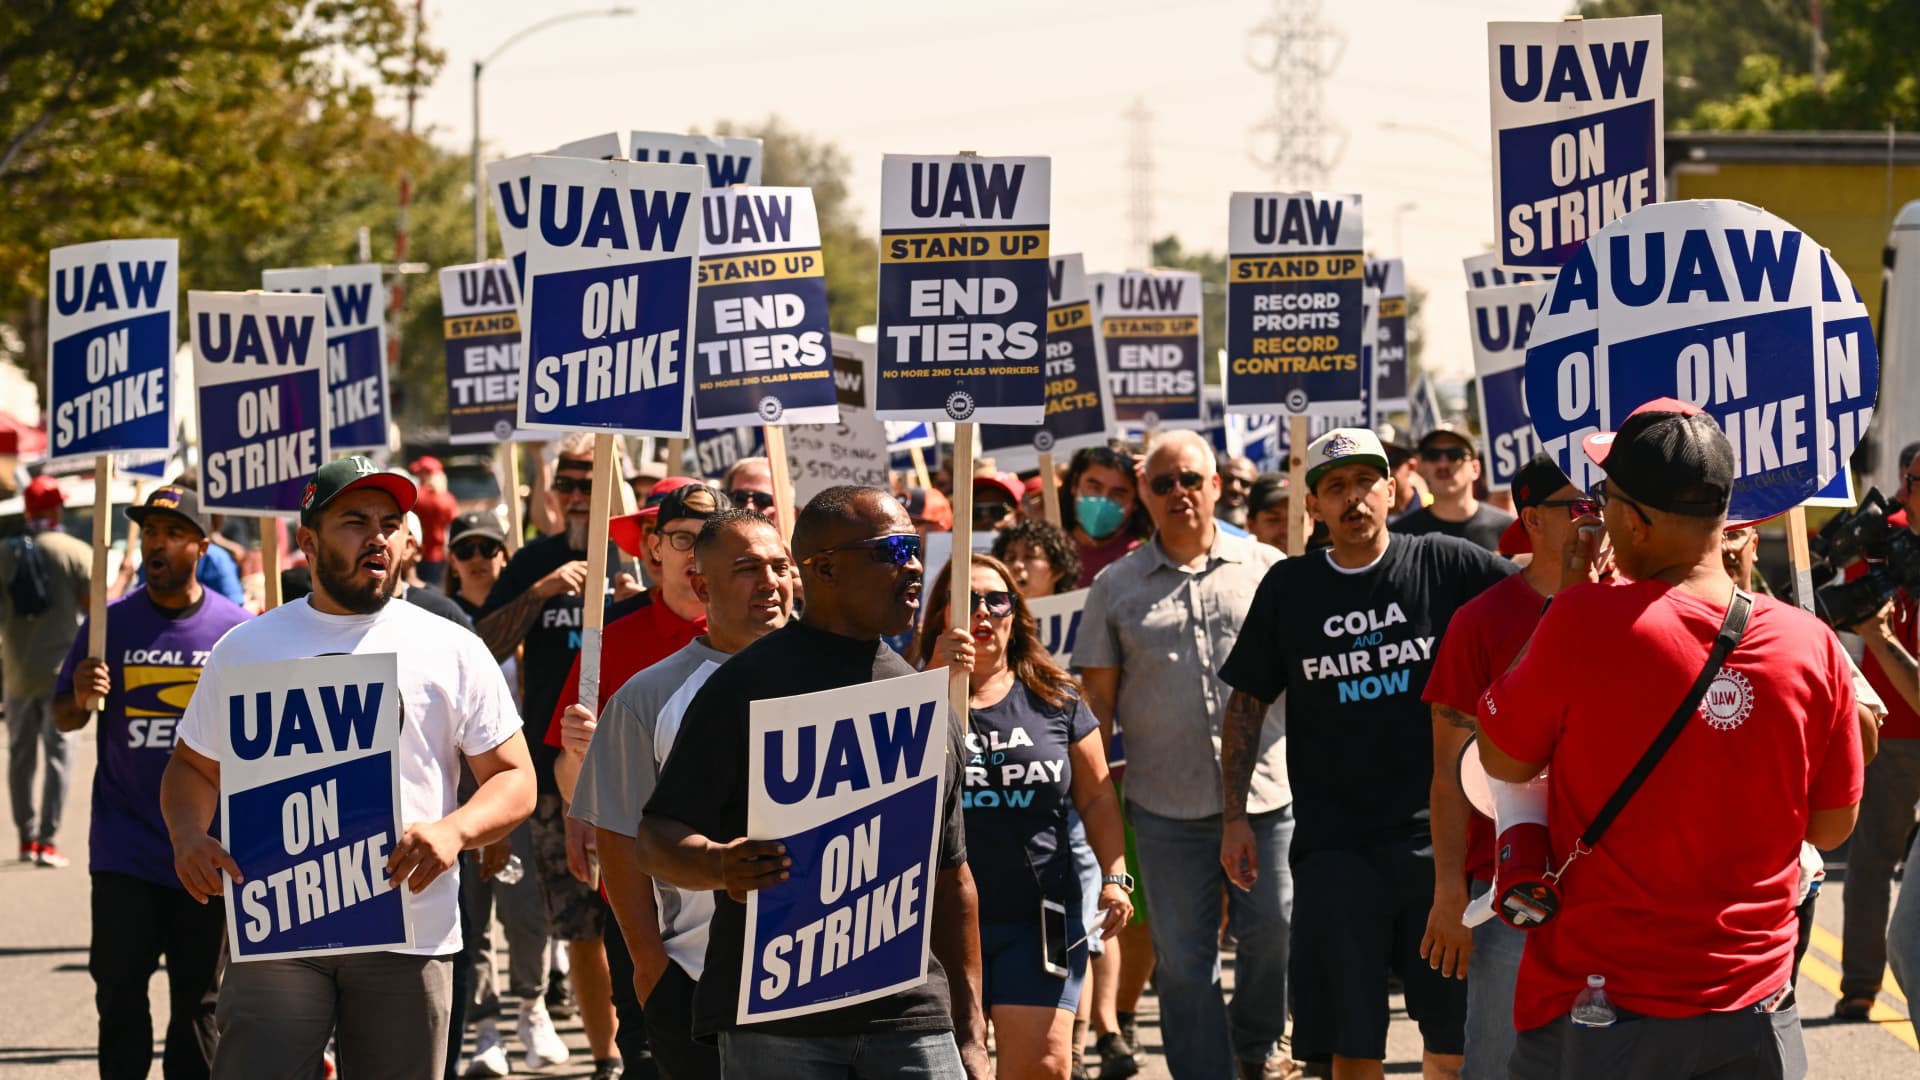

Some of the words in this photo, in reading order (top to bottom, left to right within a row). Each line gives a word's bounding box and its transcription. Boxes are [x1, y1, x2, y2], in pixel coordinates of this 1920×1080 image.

[1499, 40, 1650, 103] UAW
[1550, 123, 1605, 188] ON
[911, 162, 1026, 219] UAW
[1508, 167, 1649, 257] STRIKE
[540, 184, 691, 252] UAW
[702, 195, 793, 245] UAW
[1254, 198, 1343, 245] UAW
[698, 260, 776, 282] STAND
[785, 255, 814, 274] UP
[890, 237, 990, 259] STAND
[1000, 235, 1040, 255] UP
[1238, 261, 1319, 279] STAND
[1327, 259, 1356, 275] UP
[1610, 229, 1802, 307] UAW
[56, 261, 167, 316] UAW
[581, 274, 638, 340] ON
[910, 278, 1018, 317] END
[1119, 277, 1184, 311] UAW
[1253, 293, 1340, 311] RECORD
[452, 316, 514, 335] STAND
[713, 293, 806, 334] END
[1054, 309, 1084, 328] UP
[1109, 319, 1164, 333] STAND
[1169, 317, 1194, 332] UP
[1252, 312, 1341, 331] PROFITS
[1476, 300, 1538, 352] UA
[86, 327, 128, 384] ON
[198, 312, 314, 365] UAW
[698, 331, 827, 375] TIERS
[887, 321, 1039, 363] TIERS
[1118, 345, 1184, 369] END
[1253, 336, 1339, 353] RECORD
[328, 343, 347, 385] N
[534, 329, 680, 414] STRIKE
[883, 369, 898, 378] NO
[901, 369, 930, 377] MORE
[932, 368, 951, 376] 2ND
[953, 367, 986, 376] CLASS
[989, 365, 1039, 375] WORKERS
[1111, 371, 1195, 395] TIERS
[1232, 355, 1357, 374] CONTRACTS
[1557, 345, 1601, 421] O
[1676, 331, 1747, 408] ON
[1827, 332, 1861, 404] N
[56, 368, 164, 449] STRIKE
[238, 385, 280, 439] ON
[328, 375, 380, 430] IKE
[1725, 395, 1807, 480] IKE
[207, 429, 317, 499] STRIKE
[544, 607, 584, 628] FAI
[1323, 601, 1408, 638] COLA
[1352, 631, 1384, 649] AND
[124, 650, 184, 665] LOCAL
[1302, 650, 1373, 681] FAIR
[1379, 636, 1436, 668] PAY
[1337, 669, 1410, 704] NOW
[1711, 691, 1737, 706] UAW
[229, 682, 384, 761] UAW
[963, 727, 1034, 754] OLA
[764, 700, 937, 806] UAW
[1001, 760, 1064, 787] PAY
[282, 778, 340, 856] ON
[819, 814, 881, 905] ON
[241, 832, 396, 943] STRIKE
[760, 862, 922, 1001] STRIKE
